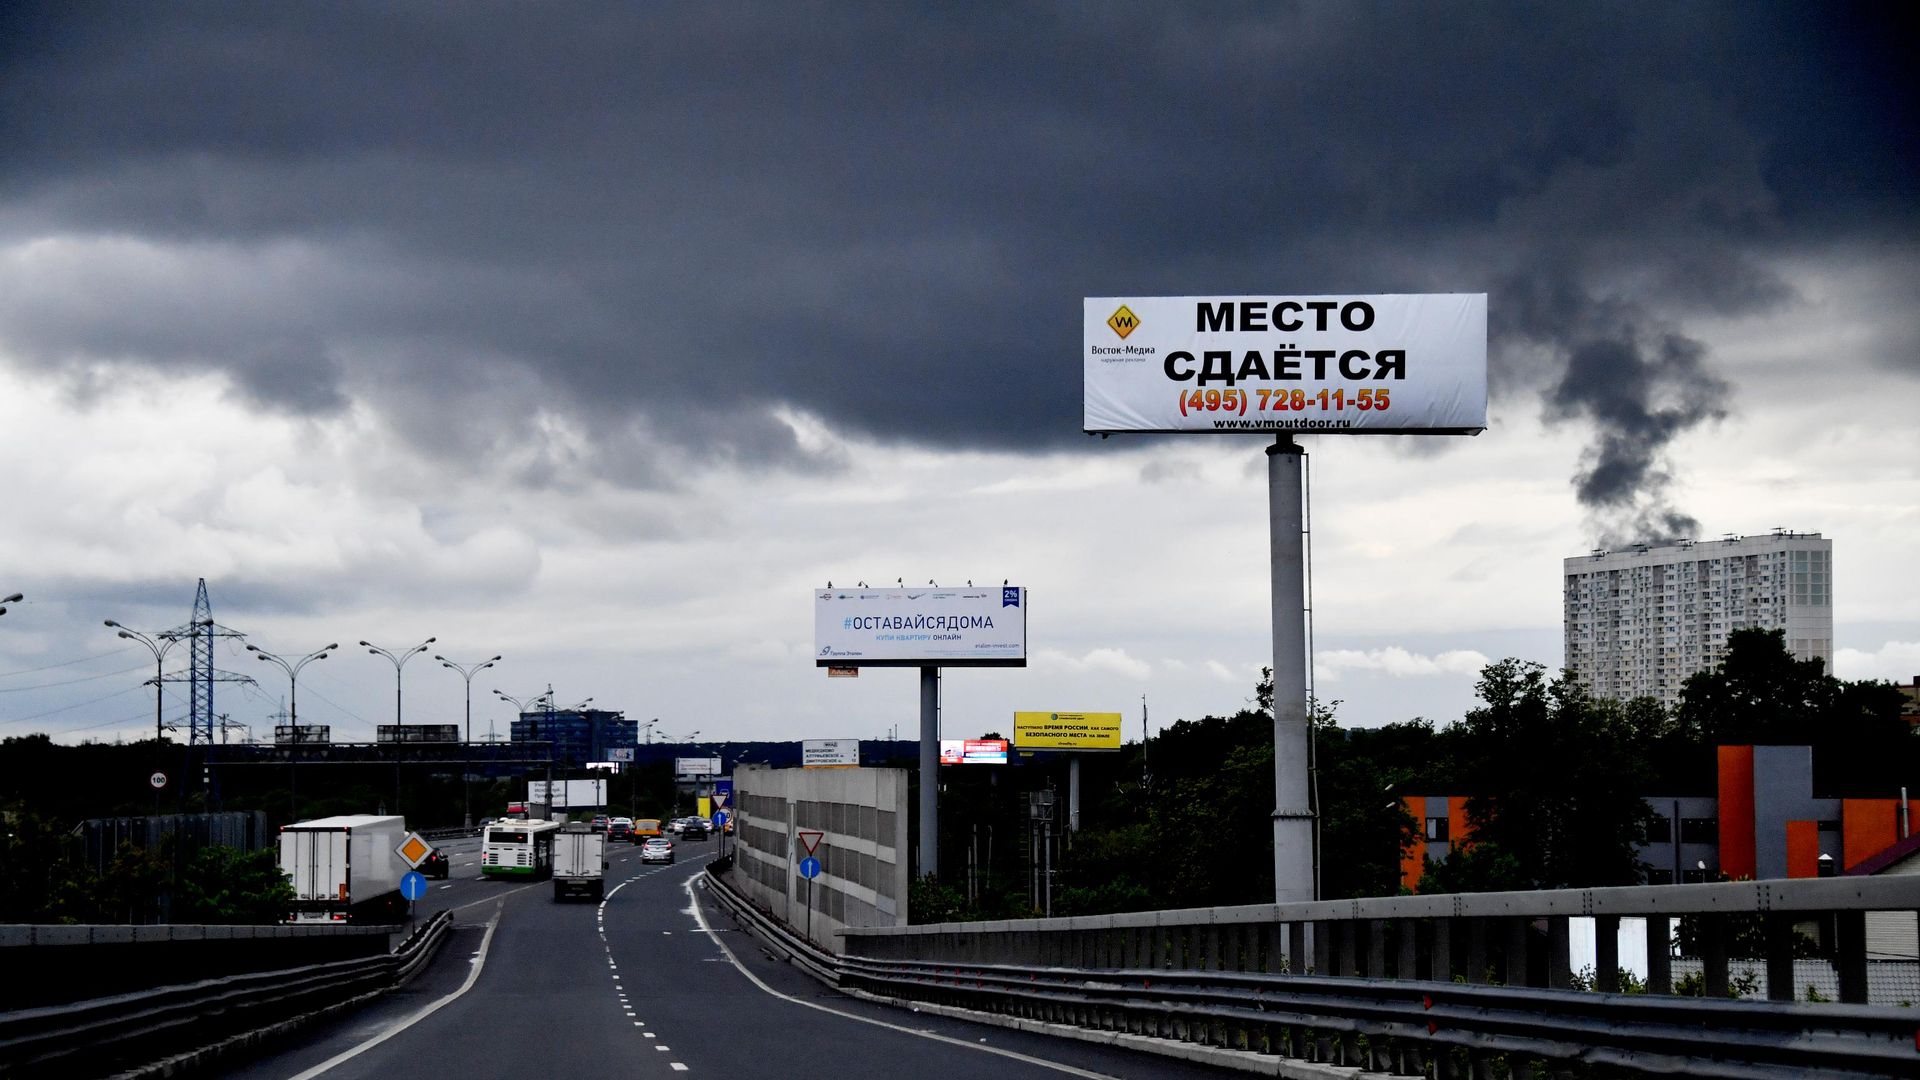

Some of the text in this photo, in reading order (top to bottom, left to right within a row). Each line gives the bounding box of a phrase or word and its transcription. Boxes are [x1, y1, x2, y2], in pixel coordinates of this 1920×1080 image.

[1197, 301, 1375, 332] МЕСТО
[1091, 345, 1155, 356] Восток-Медиа
[1164, 343, 1406, 386] СДАЁТСЯ
[1179, 388, 1390, 417] (495) 728-11-55
[1213, 418, 1351, 429] www.vmoutdoor.ru
[1004, 590, 1018, 598] 2%
[843, 613, 994, 631] #ОСТАВАЙСЯДОМА
[933, 633, 962, 641] ОНЛАЙН
[153, 776, 165, 784] 100
